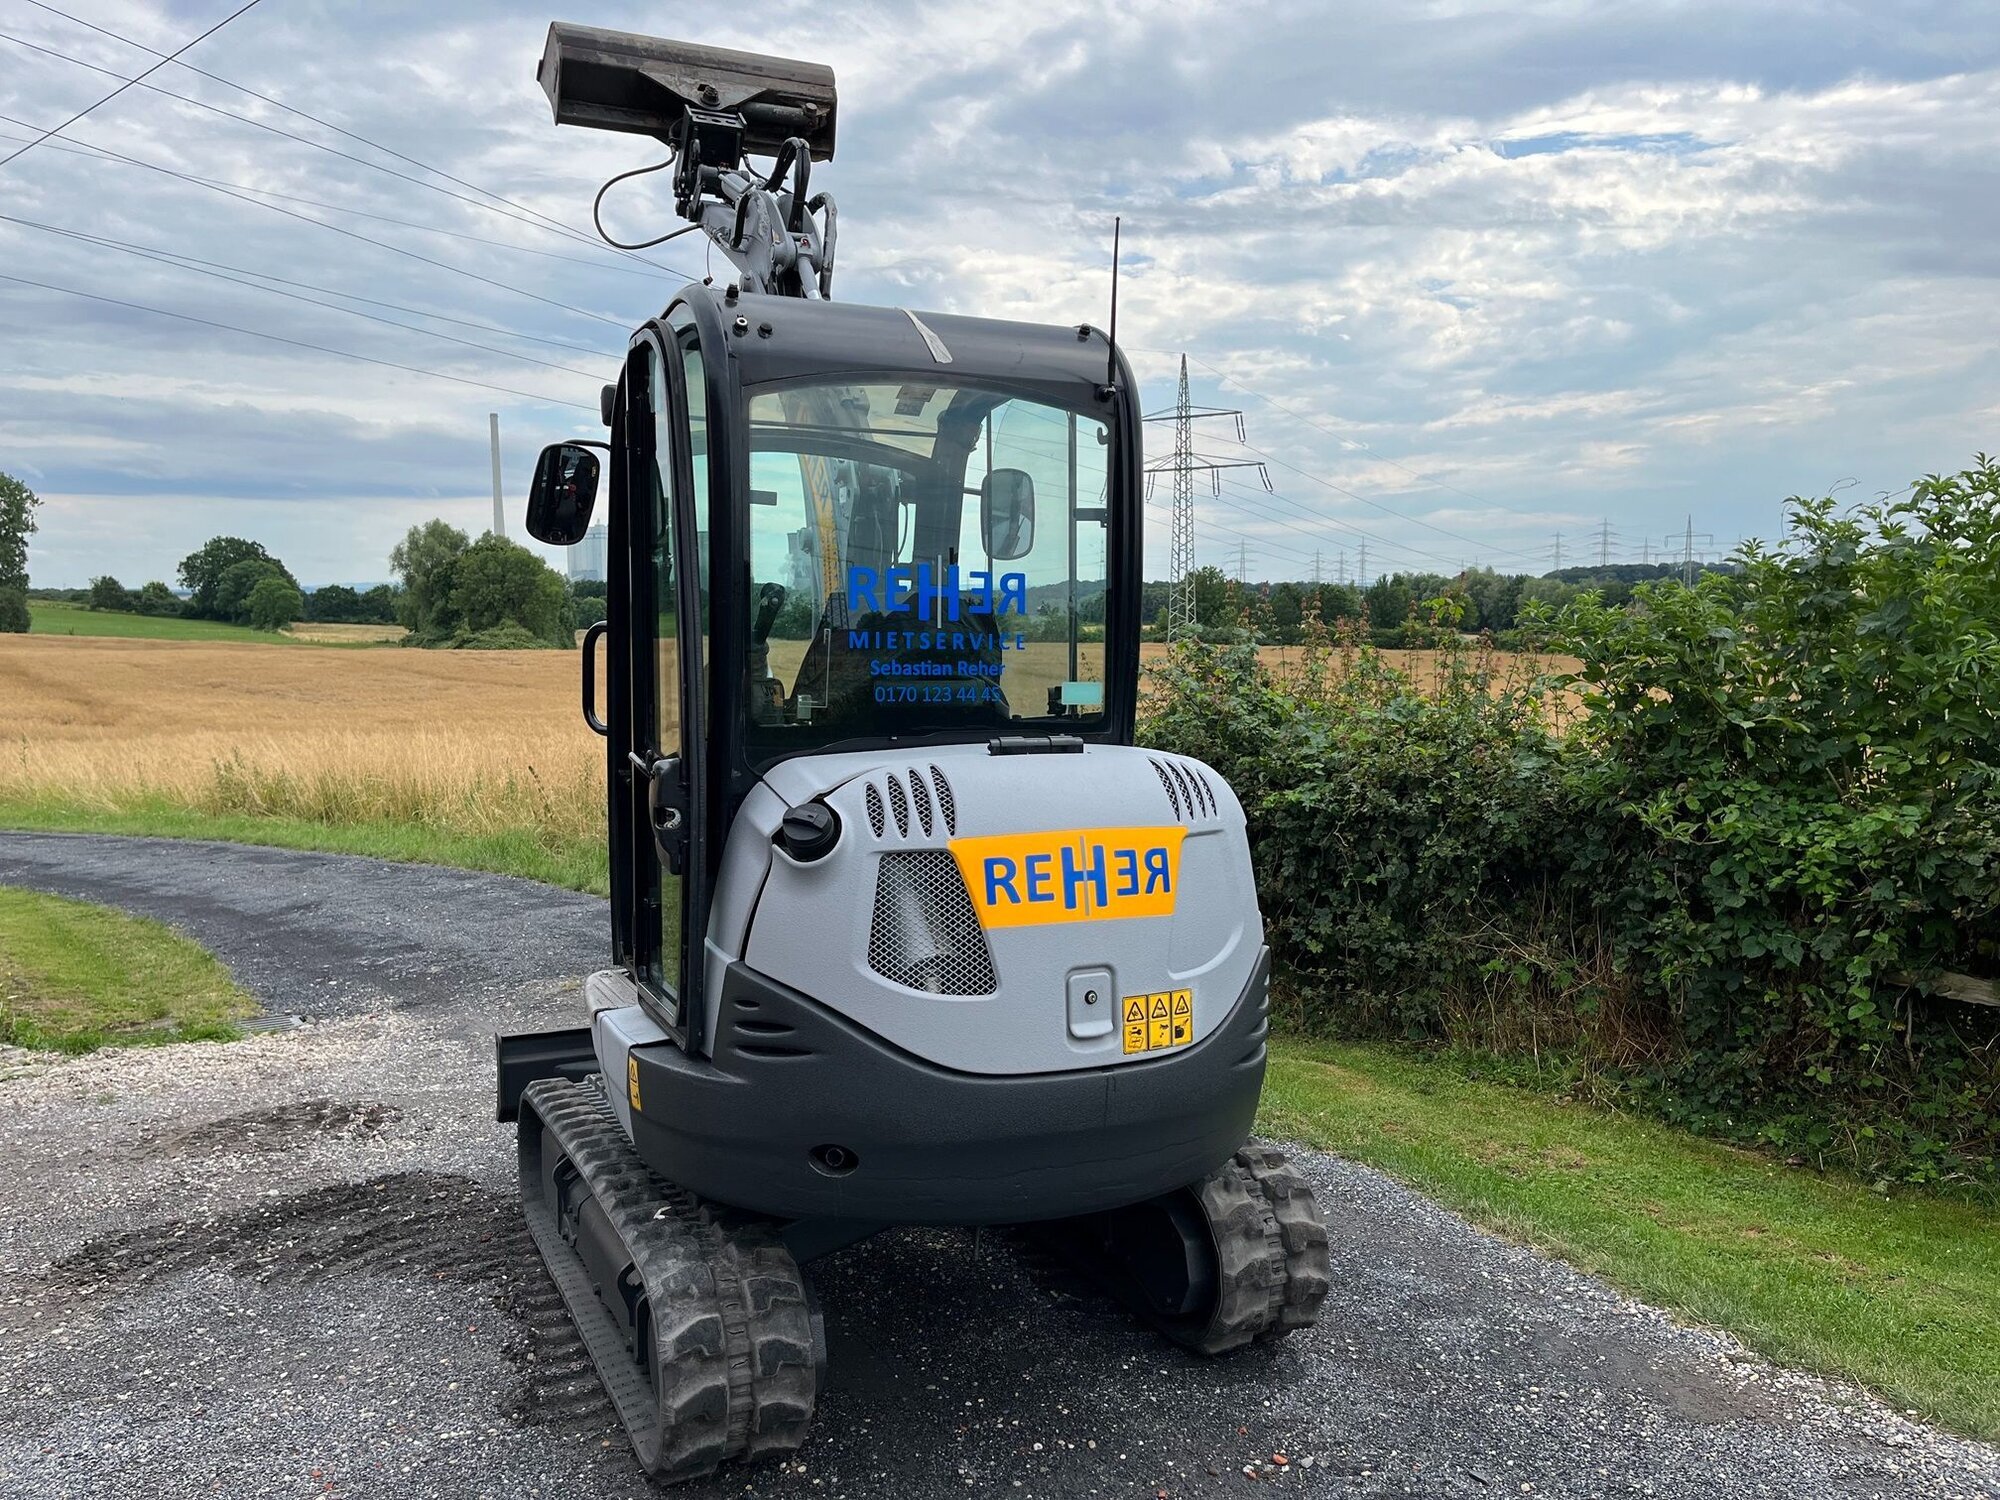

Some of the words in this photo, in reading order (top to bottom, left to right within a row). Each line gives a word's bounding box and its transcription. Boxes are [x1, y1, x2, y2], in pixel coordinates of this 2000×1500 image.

[849, 631, 1026, 651] MIETSERVICE
[870, 660, 952, 676] Sebastian
[957, 660, 1005, 676] Reher
[875, 686, 917, 703] 0170
[922, 686, 952, 703] 123
[956, 686, 977, 703] 44
